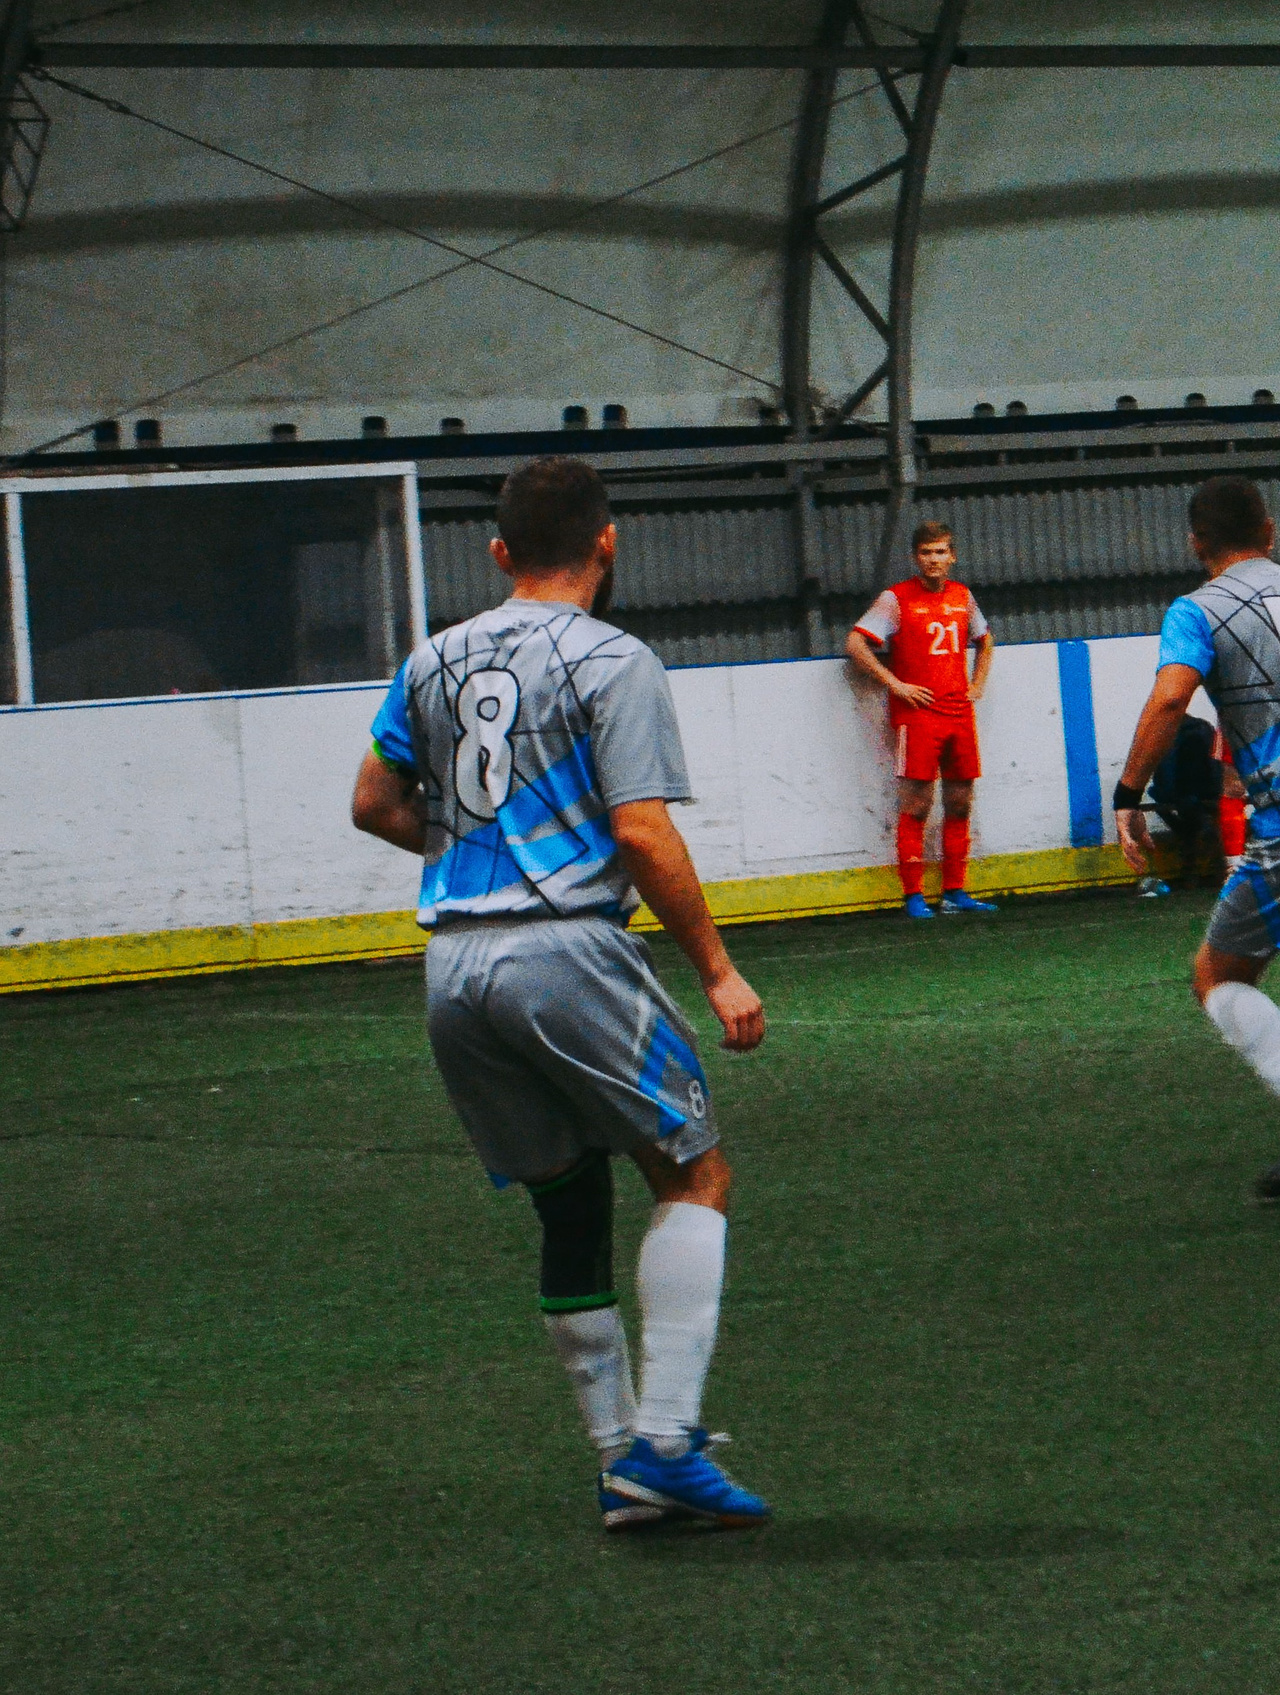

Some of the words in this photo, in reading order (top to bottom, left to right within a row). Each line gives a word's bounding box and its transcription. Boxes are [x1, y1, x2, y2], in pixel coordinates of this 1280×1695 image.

[926, 620, 960, 656] 21
[454, 666, 521, 822] 8
[688, 1079, 707, 1119] 8
